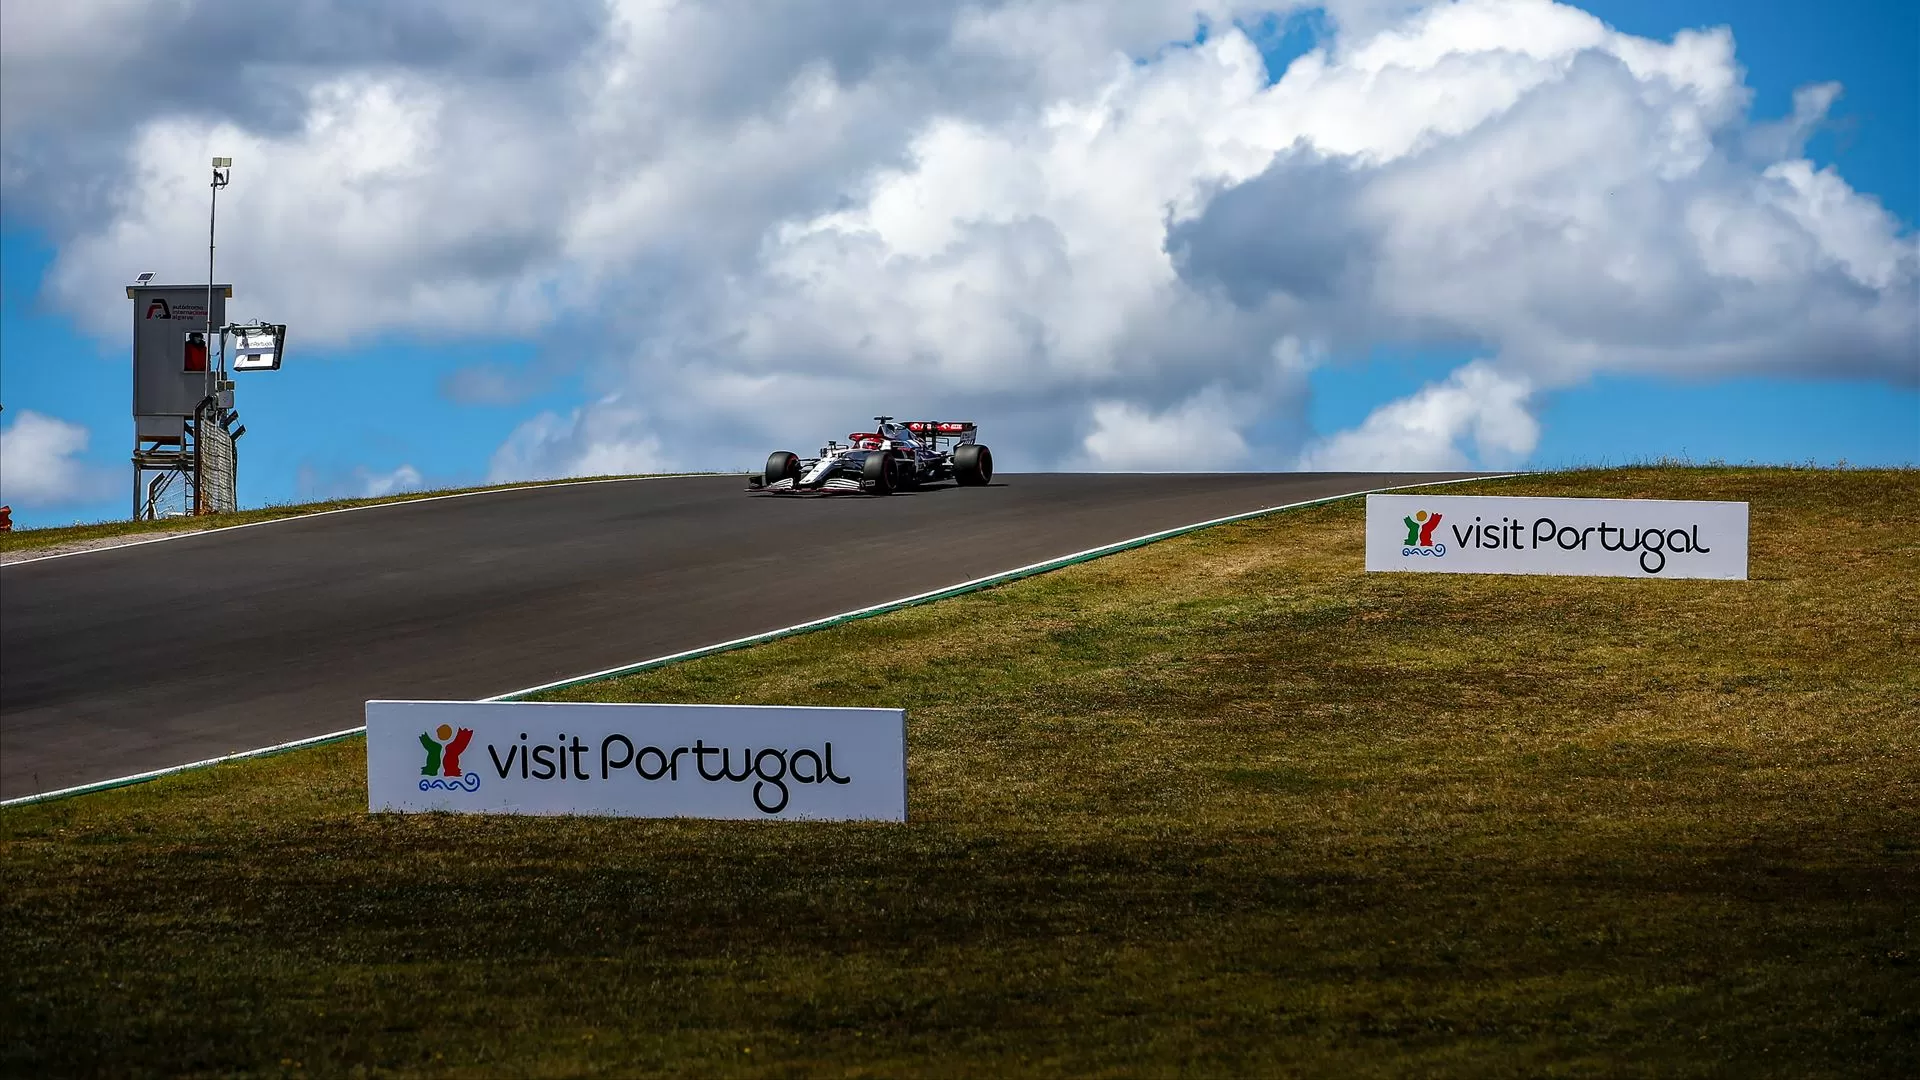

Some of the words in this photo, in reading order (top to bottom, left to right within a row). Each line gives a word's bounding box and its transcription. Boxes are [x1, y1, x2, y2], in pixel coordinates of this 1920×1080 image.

[1452, 517, 1525, 551] visit
[1533, 518, 1711, 574] Portugal
[488, 732, 590, 781] visit
[601, 733, 851, 815] Portugal
